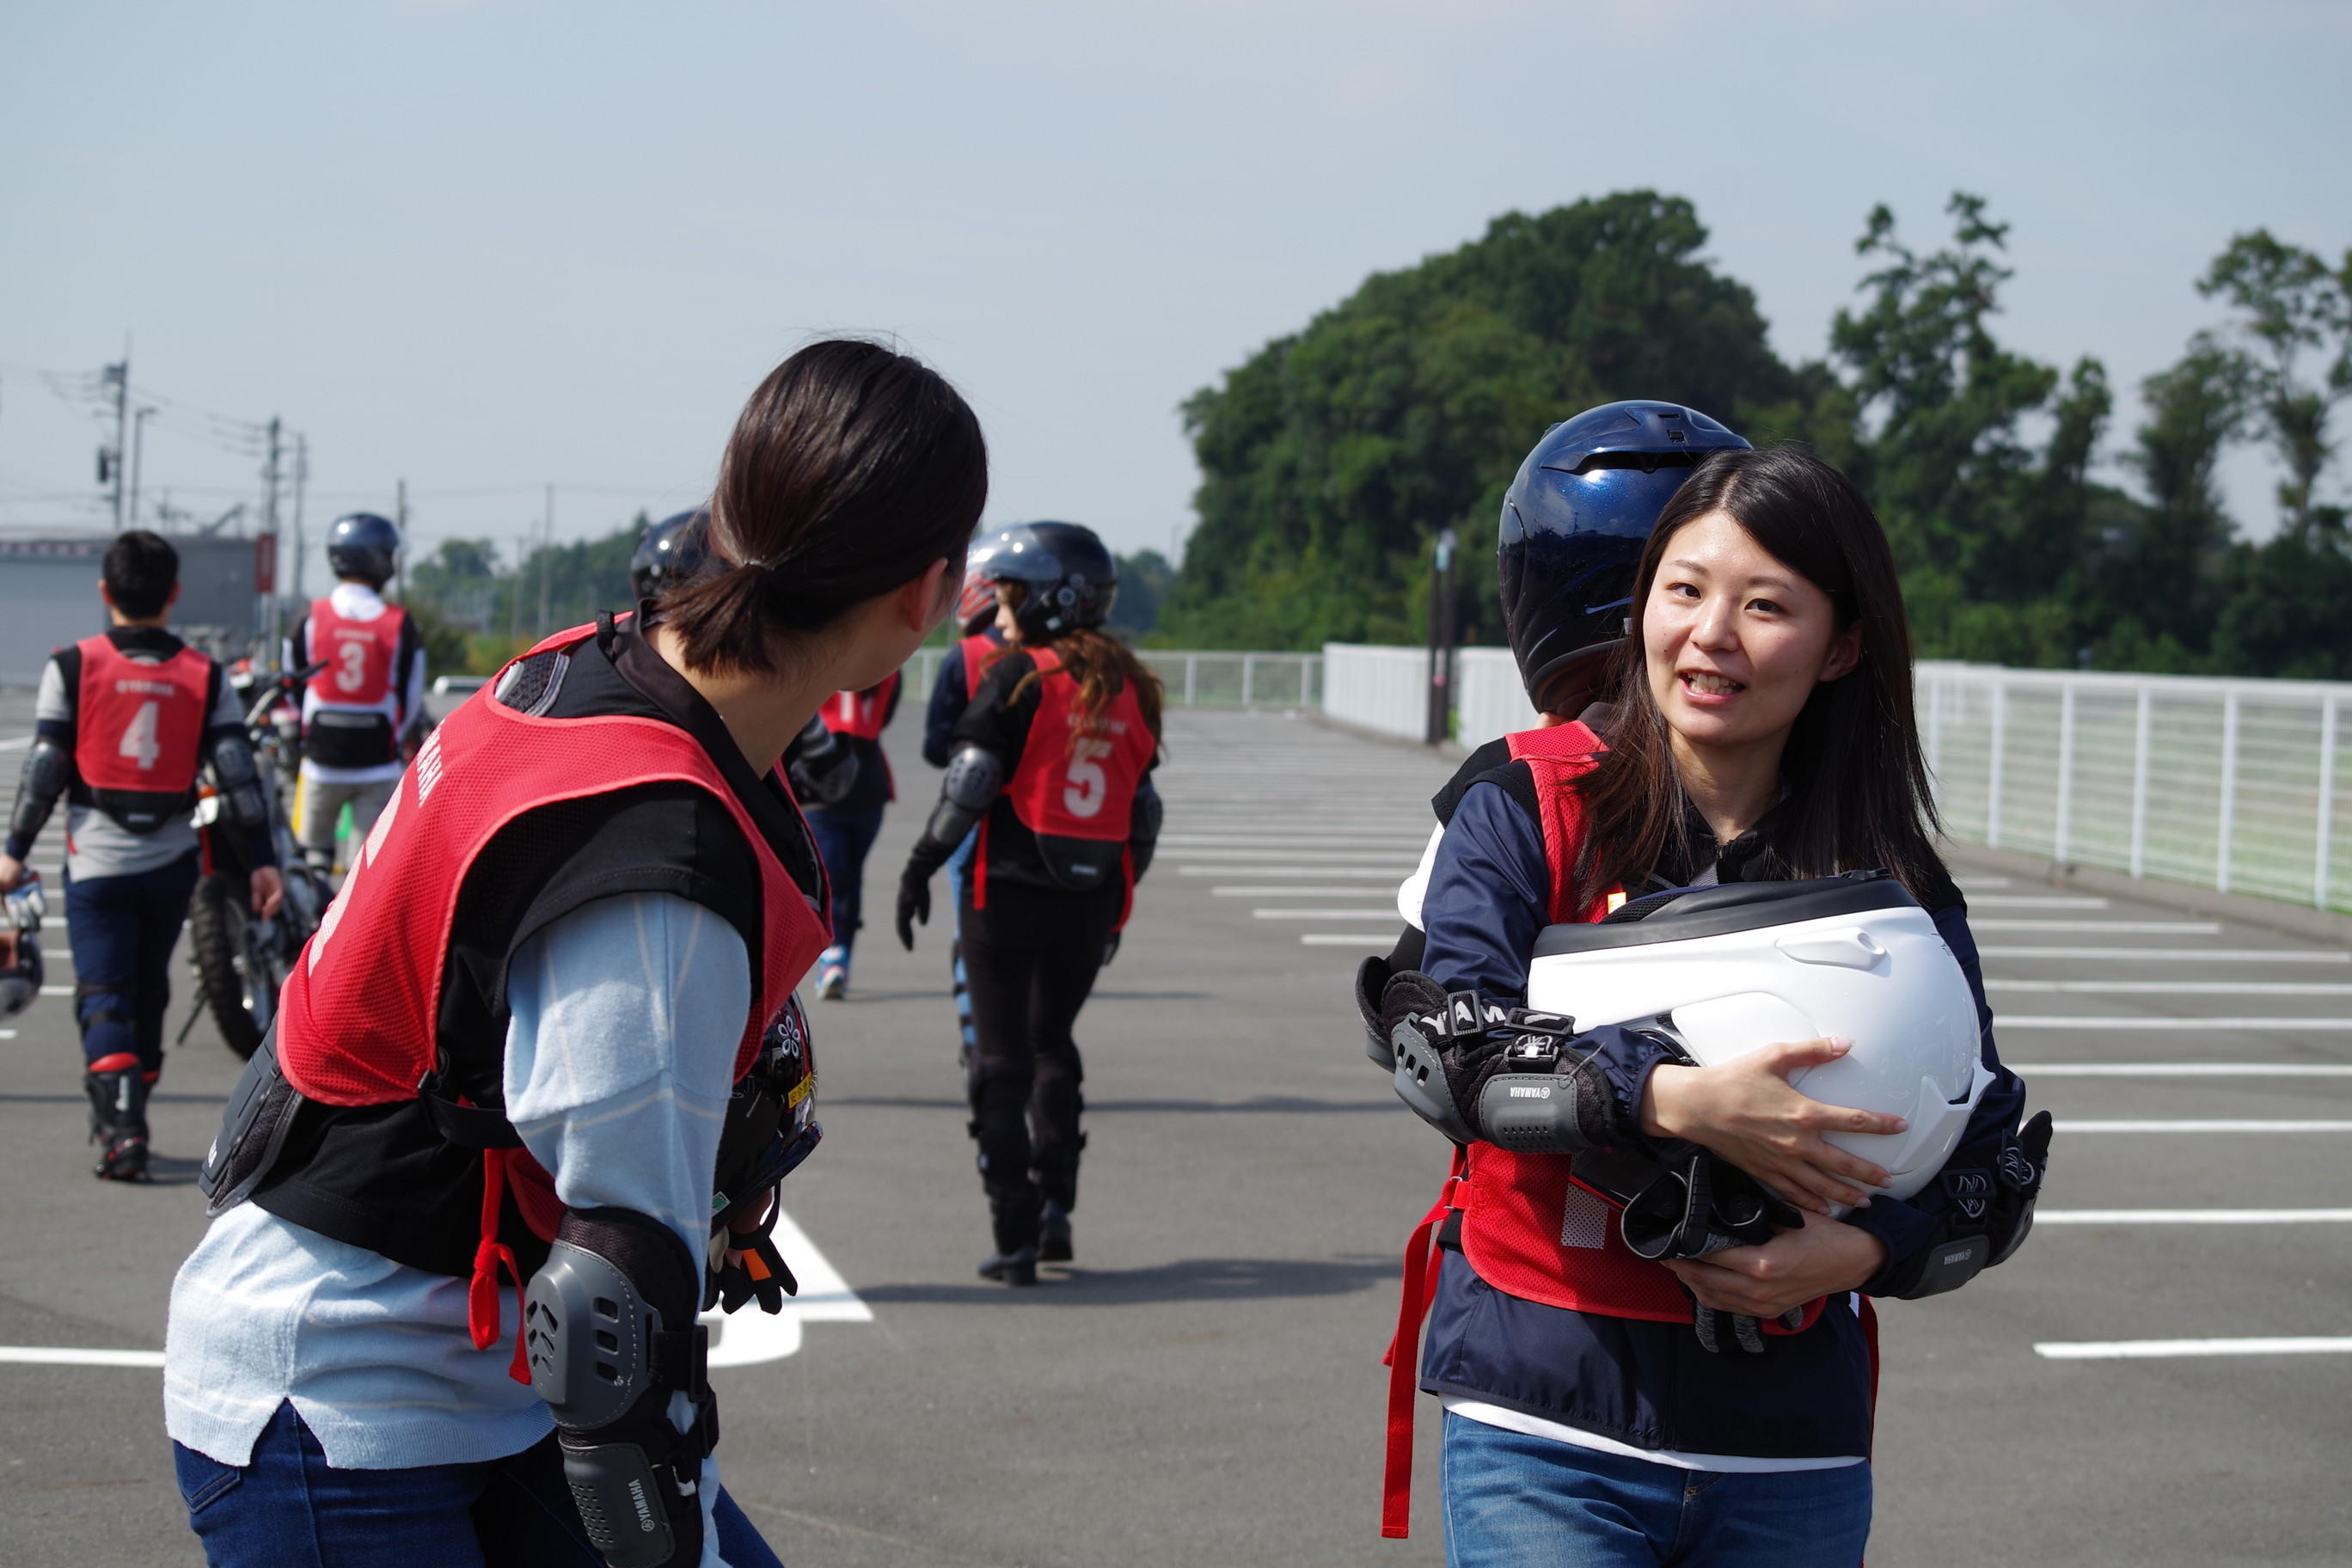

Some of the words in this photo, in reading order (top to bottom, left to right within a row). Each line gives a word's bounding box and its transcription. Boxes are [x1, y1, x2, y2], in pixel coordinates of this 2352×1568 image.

[335, 641, 365, 693] 3
[119, 701, 161, 770] 4
[1063, 737, 1113, 818] 5
[1510, 1086, 1541, 1099] YAMAHA
[628, 1478, 651, 1522] YAMAHA
